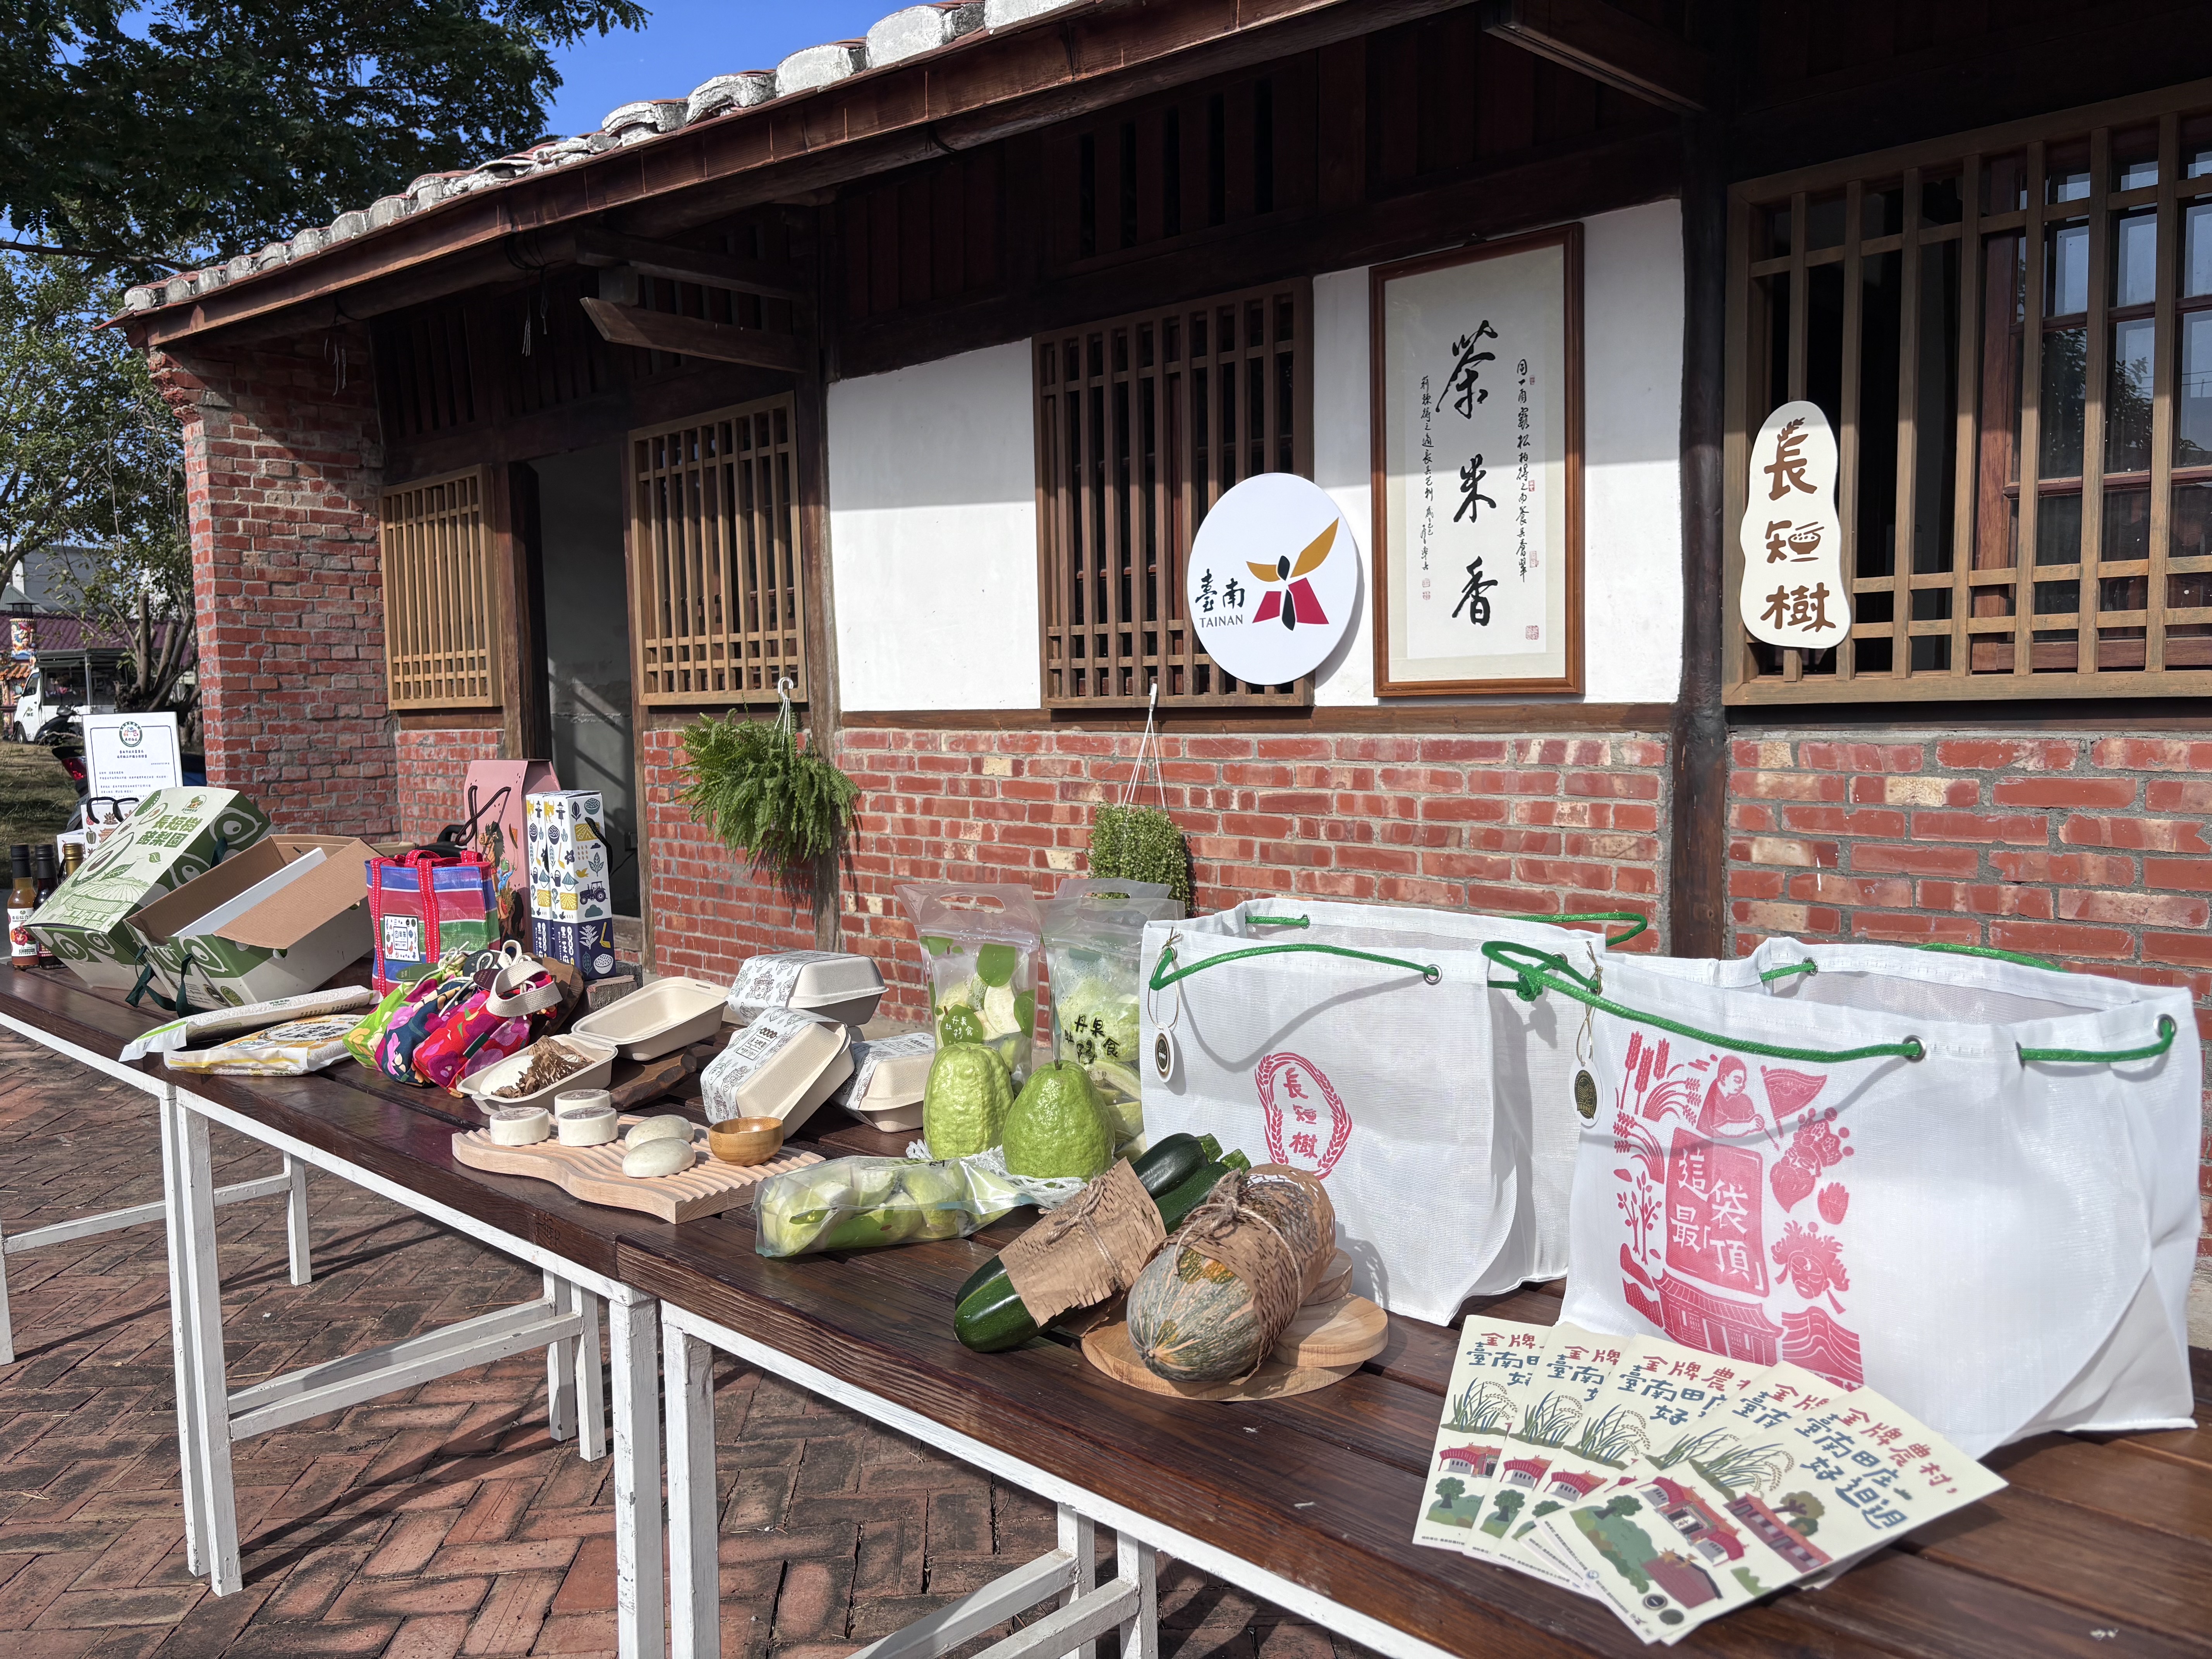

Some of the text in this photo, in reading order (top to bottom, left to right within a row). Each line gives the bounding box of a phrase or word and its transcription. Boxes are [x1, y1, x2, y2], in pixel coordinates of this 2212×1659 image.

[1195, 568, 1245, 613] 臺南
[1199, 614, 1243, 628] TAINAN
[151, 815, 203, 833] 長短樹
[135, 830, 189, 848] 酪梨園
[1283, 1067, 1317, 1159] 長短樹
[1677, 1147, 1749, 1234] 這袋
[1480, 1333, 1545, 1349] 金牌
[1565, 1346, 1620, 1365] 金牌
[1546, 1354, 1604, 1385] 臺南
[1794, 1413, 1899, 1487] 臺南田庄
